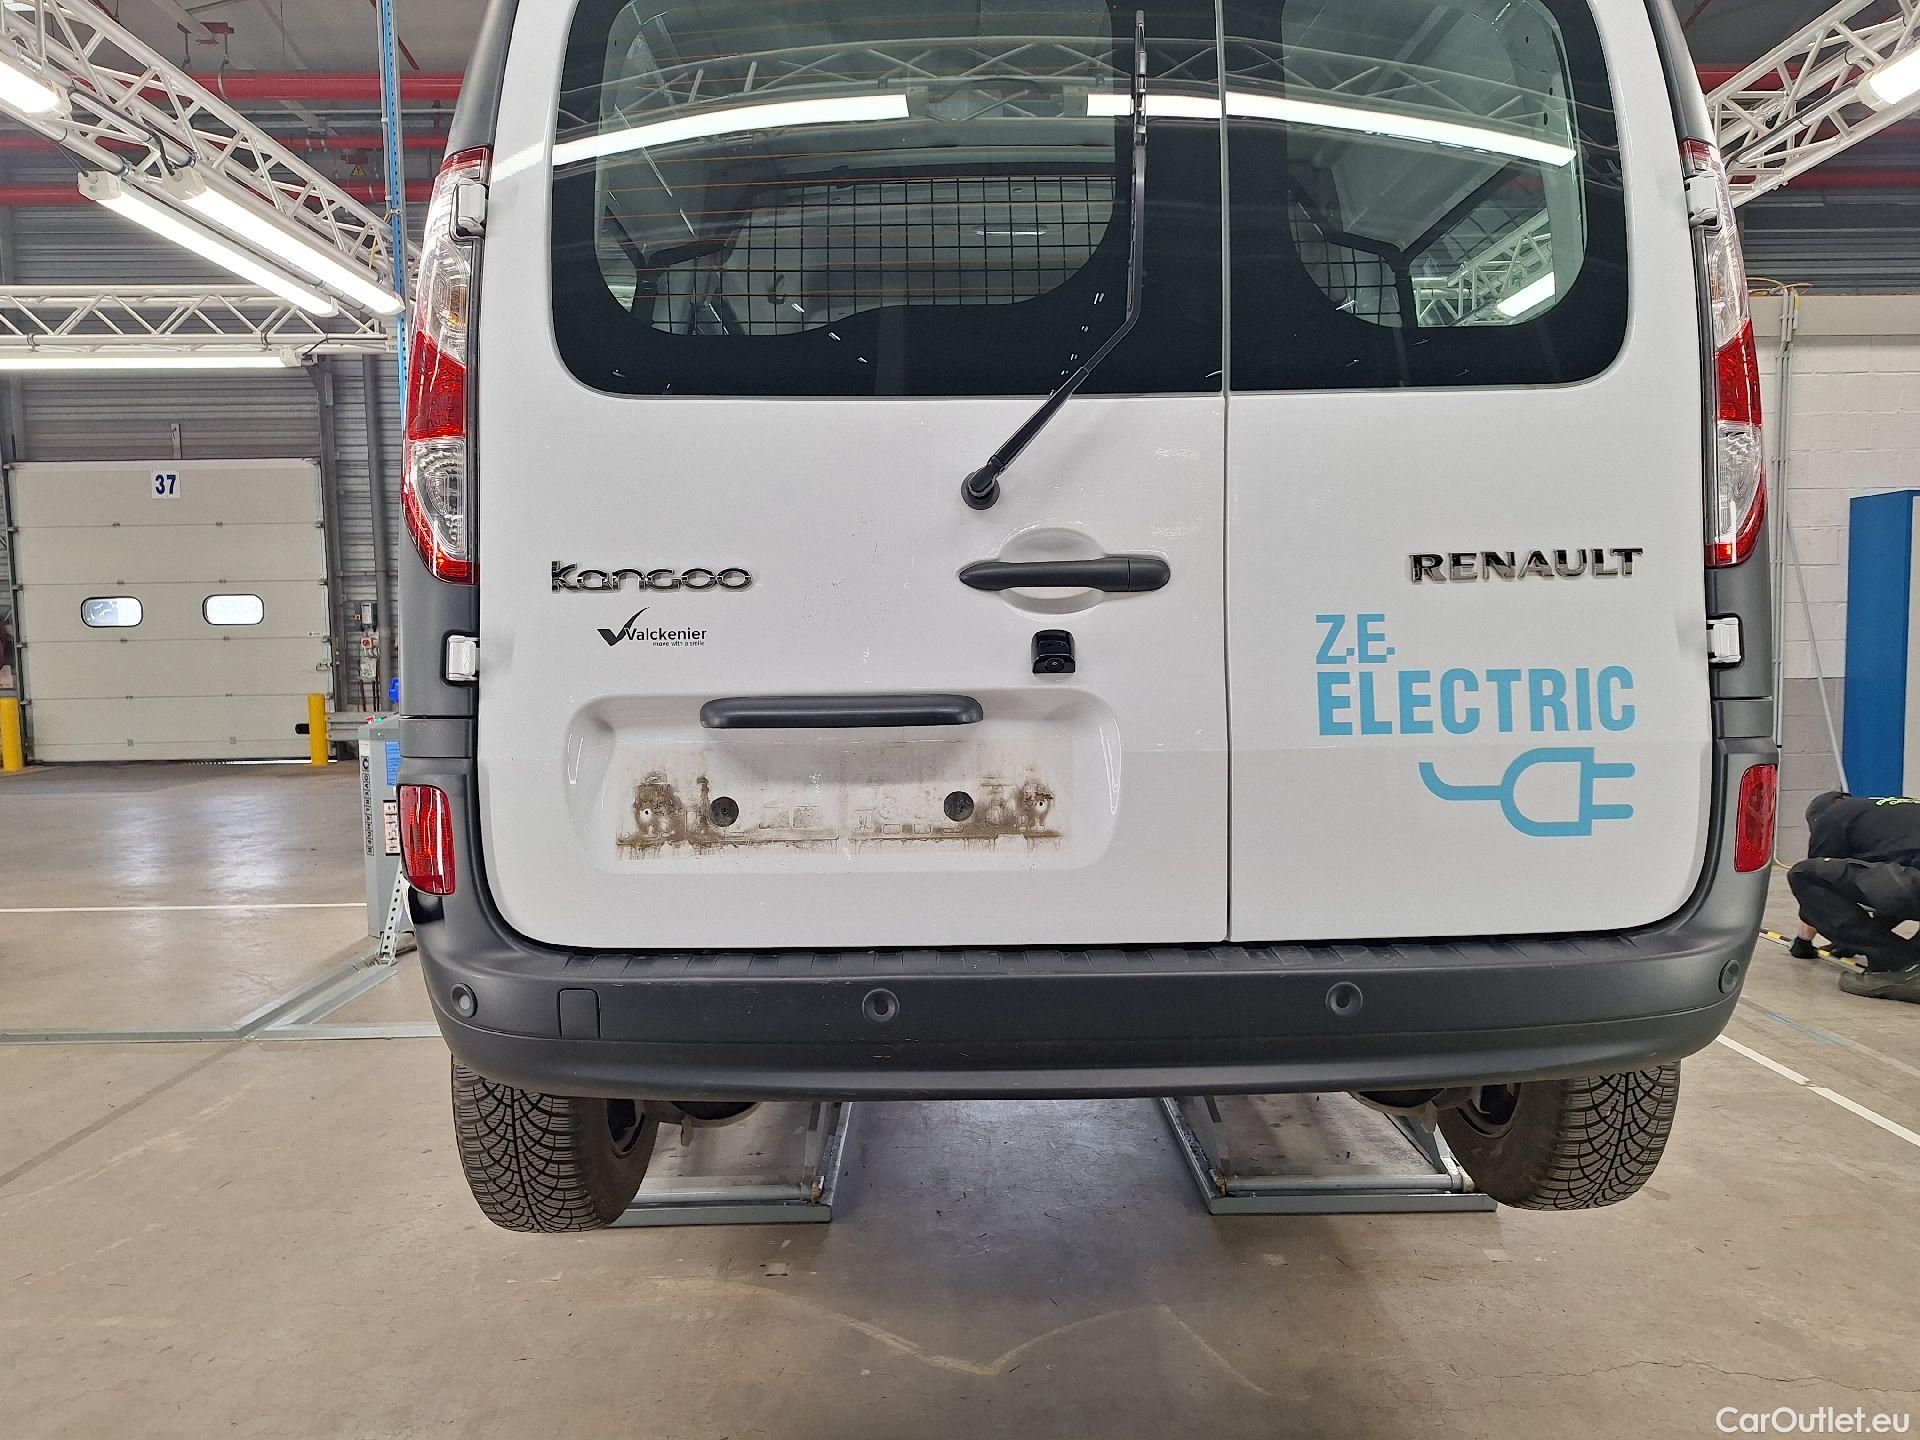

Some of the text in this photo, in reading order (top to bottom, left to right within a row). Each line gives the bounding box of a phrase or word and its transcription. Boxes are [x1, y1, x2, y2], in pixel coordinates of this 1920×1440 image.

[155, 474, 176, 495] 37
[1408, 547, 1643, 584] RENAULT
[624, 626, 708, 641] Valckenier
[1315, 613, 1396, 664] Z.E.
[1317, 665, 1636, 736] ELECTRIC
